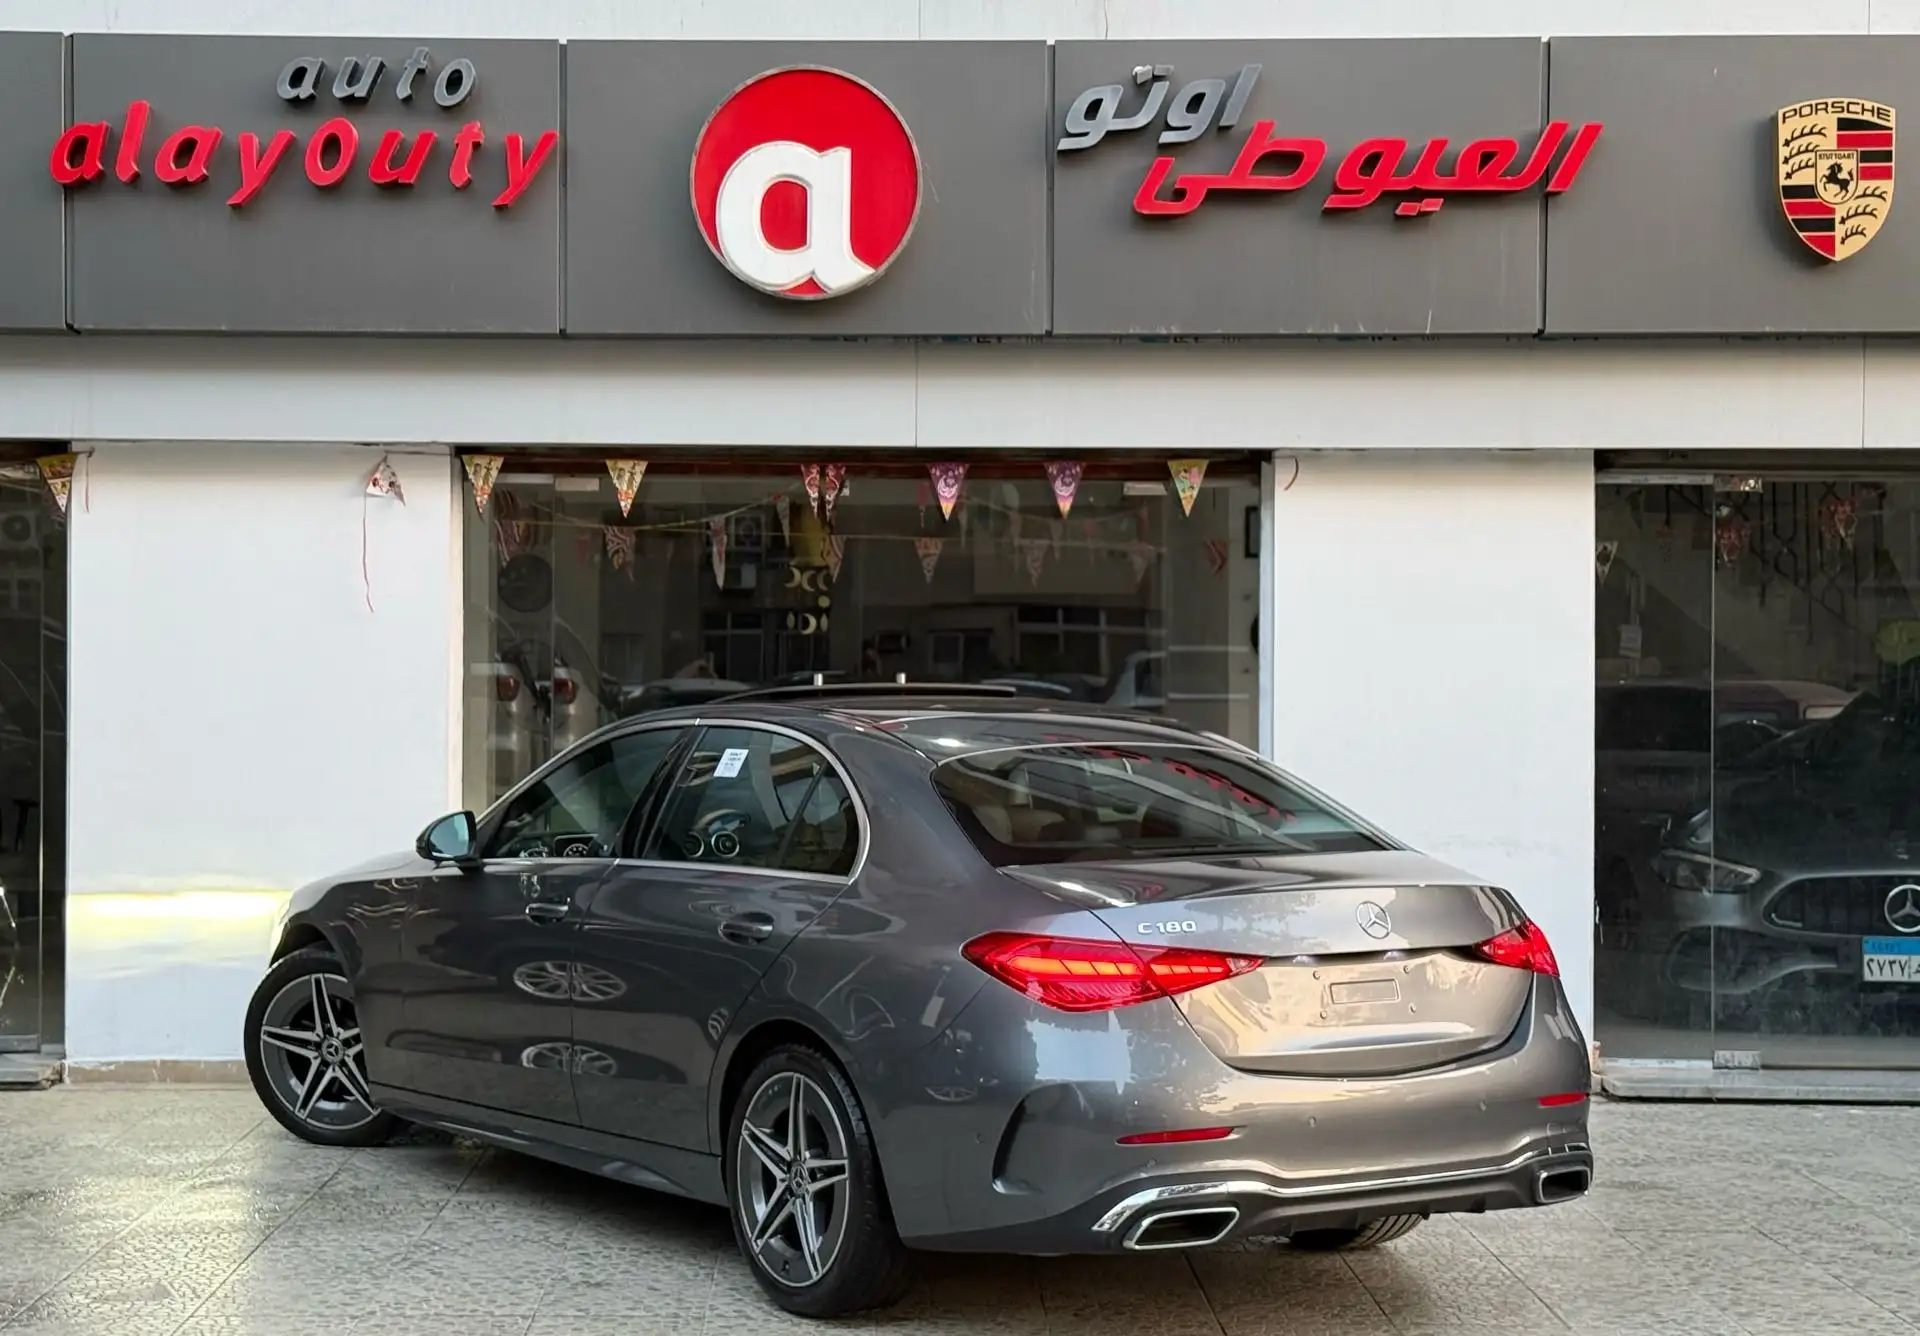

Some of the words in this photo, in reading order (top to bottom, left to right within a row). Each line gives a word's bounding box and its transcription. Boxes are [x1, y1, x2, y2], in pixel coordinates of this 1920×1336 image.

[276, 47, 476, 107] auto
[1782, 101, 1891, 124] PORSCHE
[715, 140, 876, 294] a
[1137, 922, 1153, 934] C
[1155, 920, 1197, 934] 180
